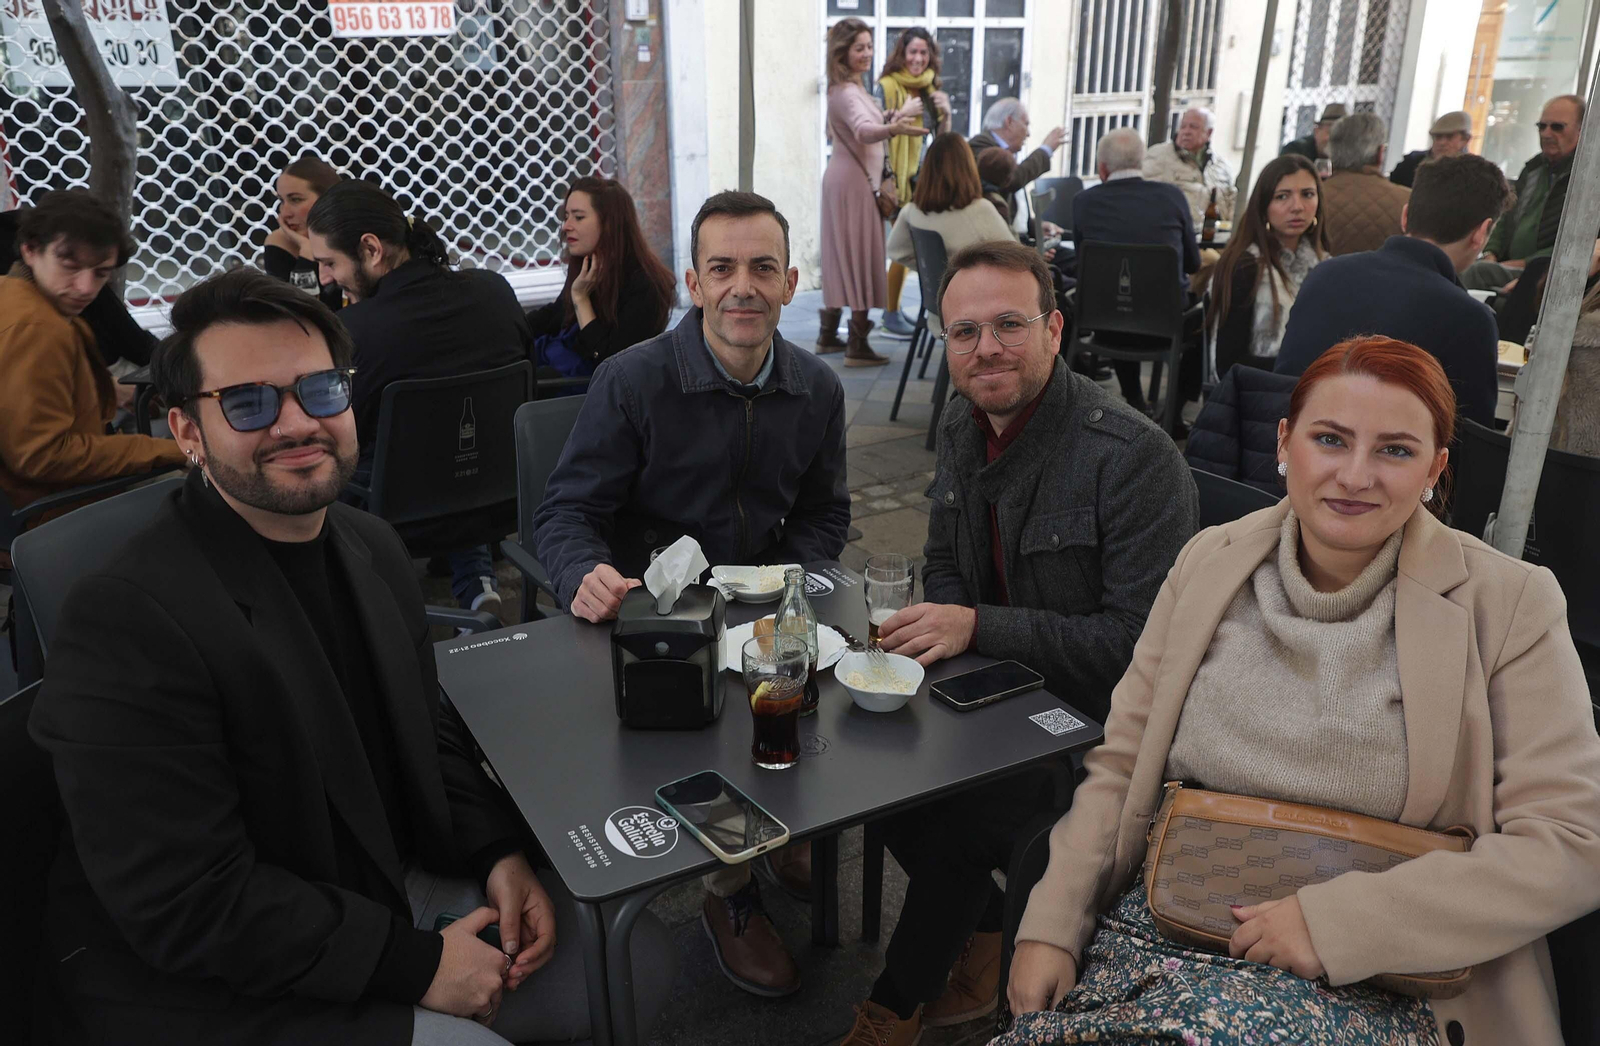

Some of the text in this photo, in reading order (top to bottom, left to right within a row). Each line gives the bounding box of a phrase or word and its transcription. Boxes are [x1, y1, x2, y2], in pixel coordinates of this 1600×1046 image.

[333, 5, 451, 31] 956 63 13 78
[470, 636, 511, 649] Xacobeo
[578, 824, 612, 867] RESISTENCIA
[617, 817, 649, 851] Galicia
[632, 811, 666, 847] Estrella
[567, 830, 598, 869] DESDE 1906
